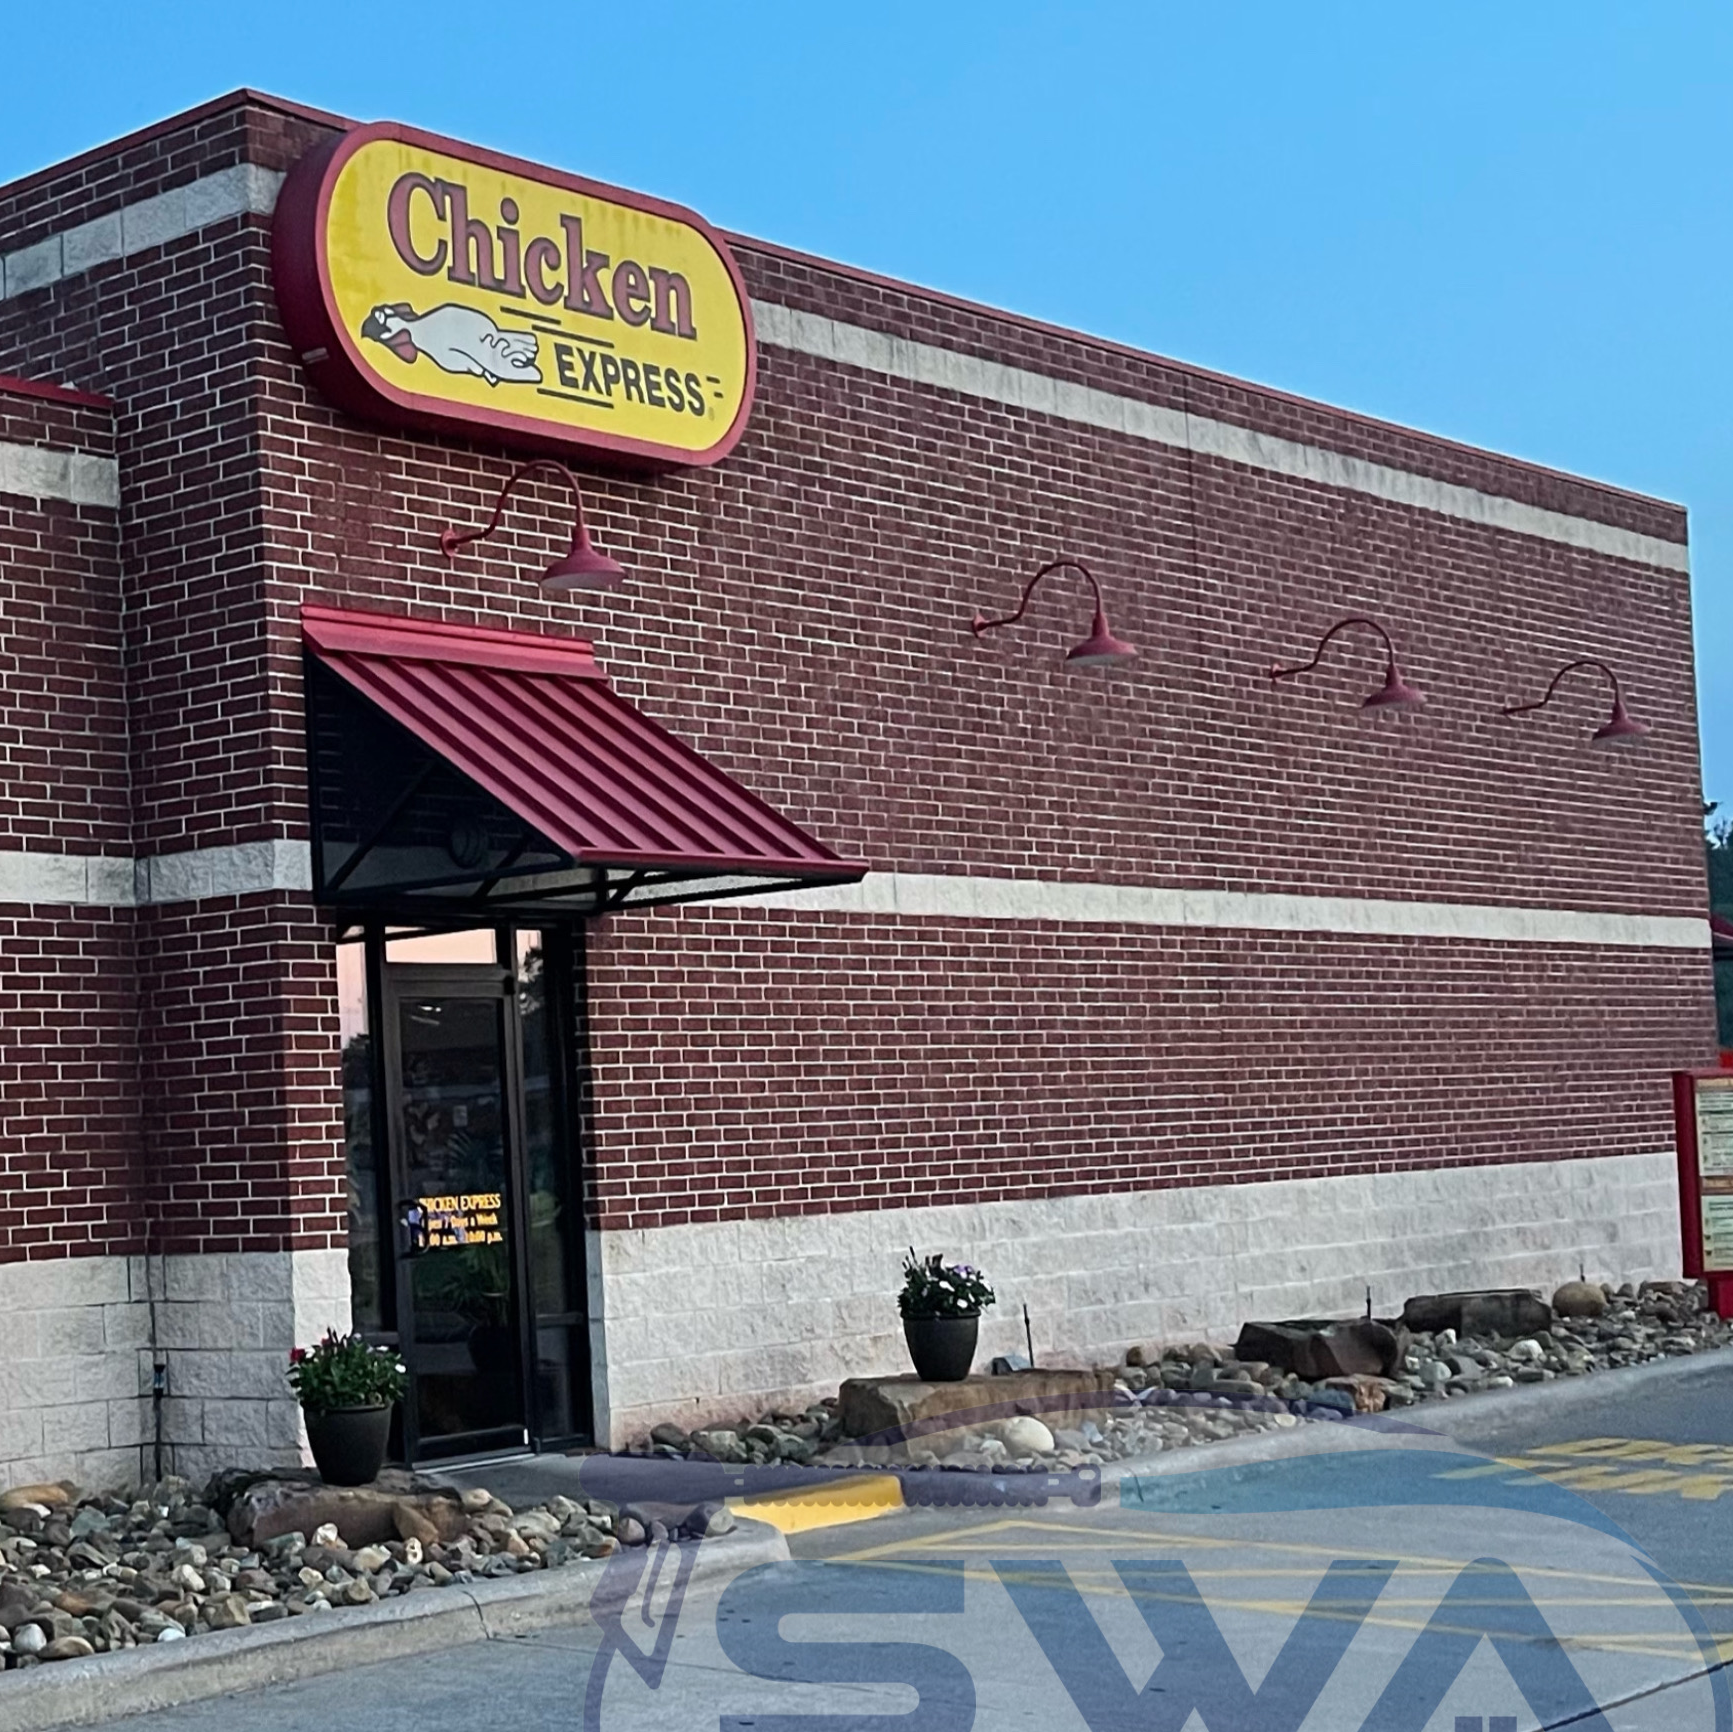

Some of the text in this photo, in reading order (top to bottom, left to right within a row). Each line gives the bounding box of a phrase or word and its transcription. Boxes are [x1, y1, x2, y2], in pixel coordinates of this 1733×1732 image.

[388, 171, 697, 341] Chicken
[554, 342, 706, 416] EXPRESS
[460, 1193, 501, 1211] EXPRESS
